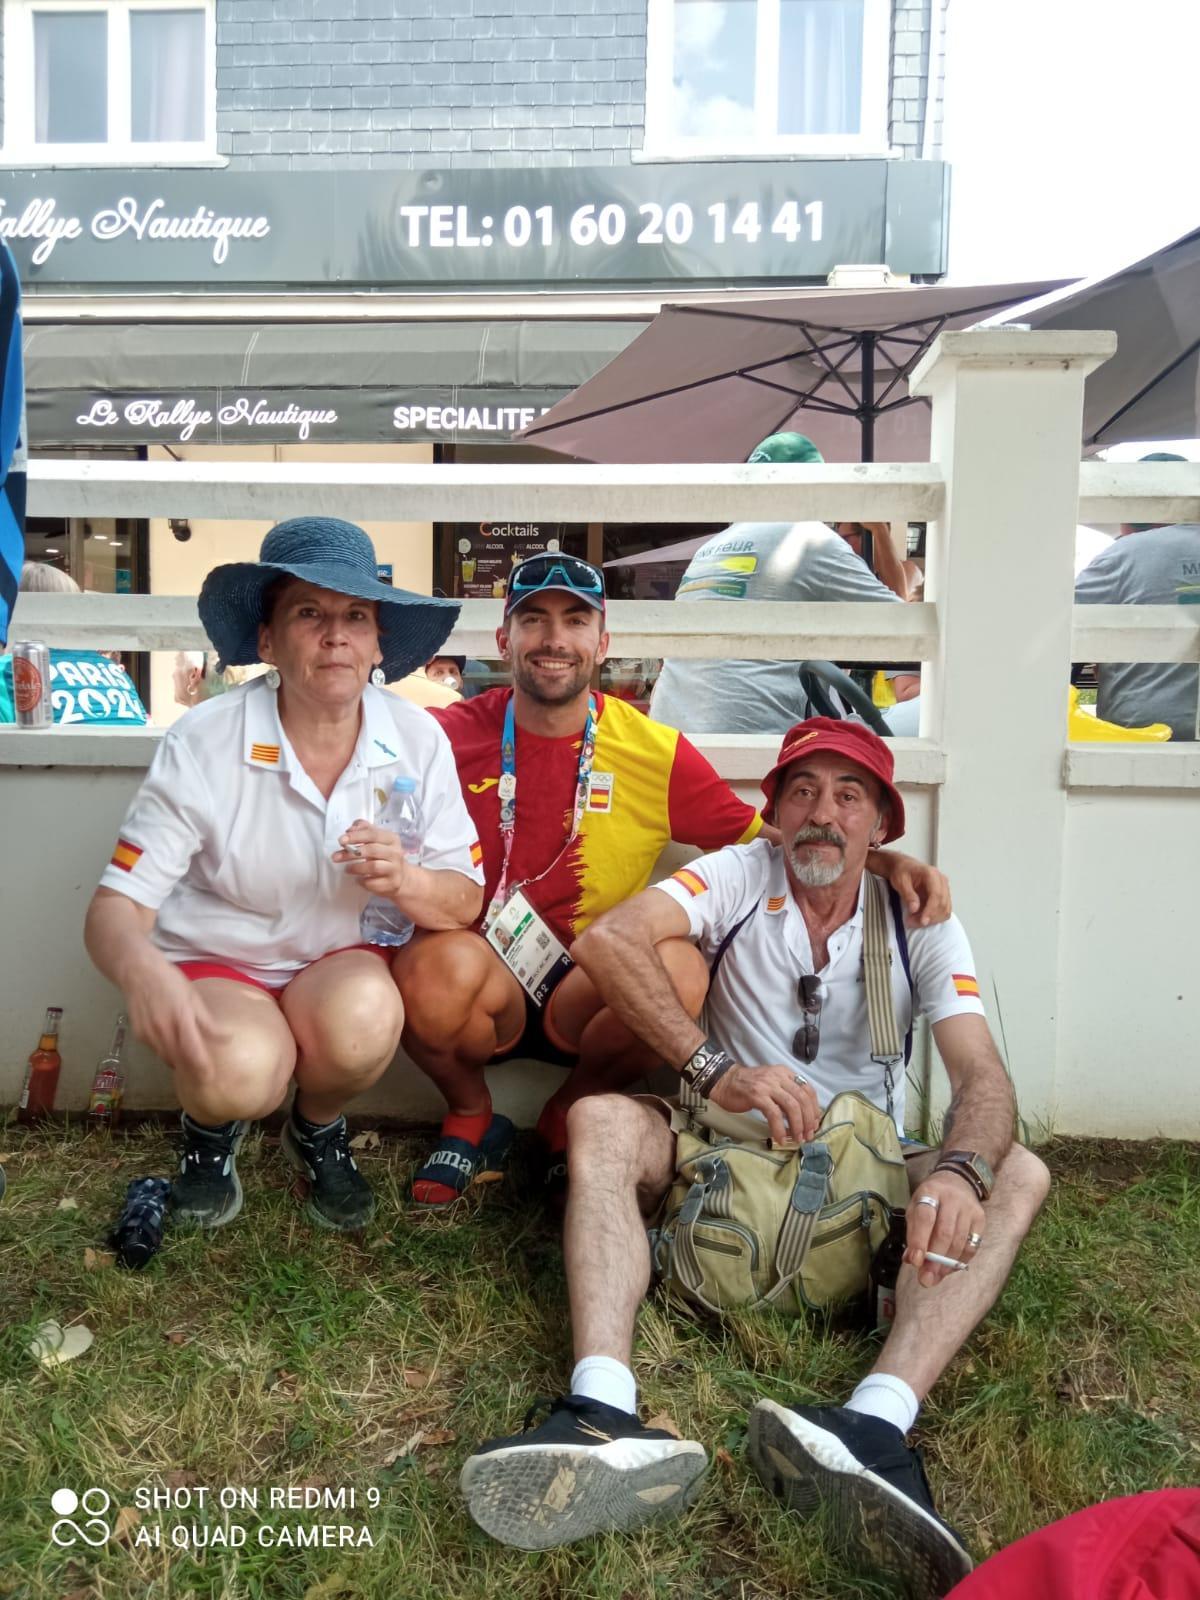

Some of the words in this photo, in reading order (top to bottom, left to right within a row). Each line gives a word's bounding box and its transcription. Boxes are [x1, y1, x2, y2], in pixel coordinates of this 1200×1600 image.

[0, 198, 83, 265] allye
[91, 197, 271, 265] Nautique
[400, 205, 493, 247] TEL:
[503, 205, 553, 246] 01
[570, 204, 626, 246] 60
[637, 202, 693, 244] 20
[707, 201, 762, 243] 14
[771, 201, 824, 242] 41
[76, 399, 119, 426] Le
[124, 399, 213, 441] Rallye
[217, 398, 338, 440] Nautique
[393, 407, 536, 431] SPECIALITE
[480, 522, 539, 536] Cocktails
